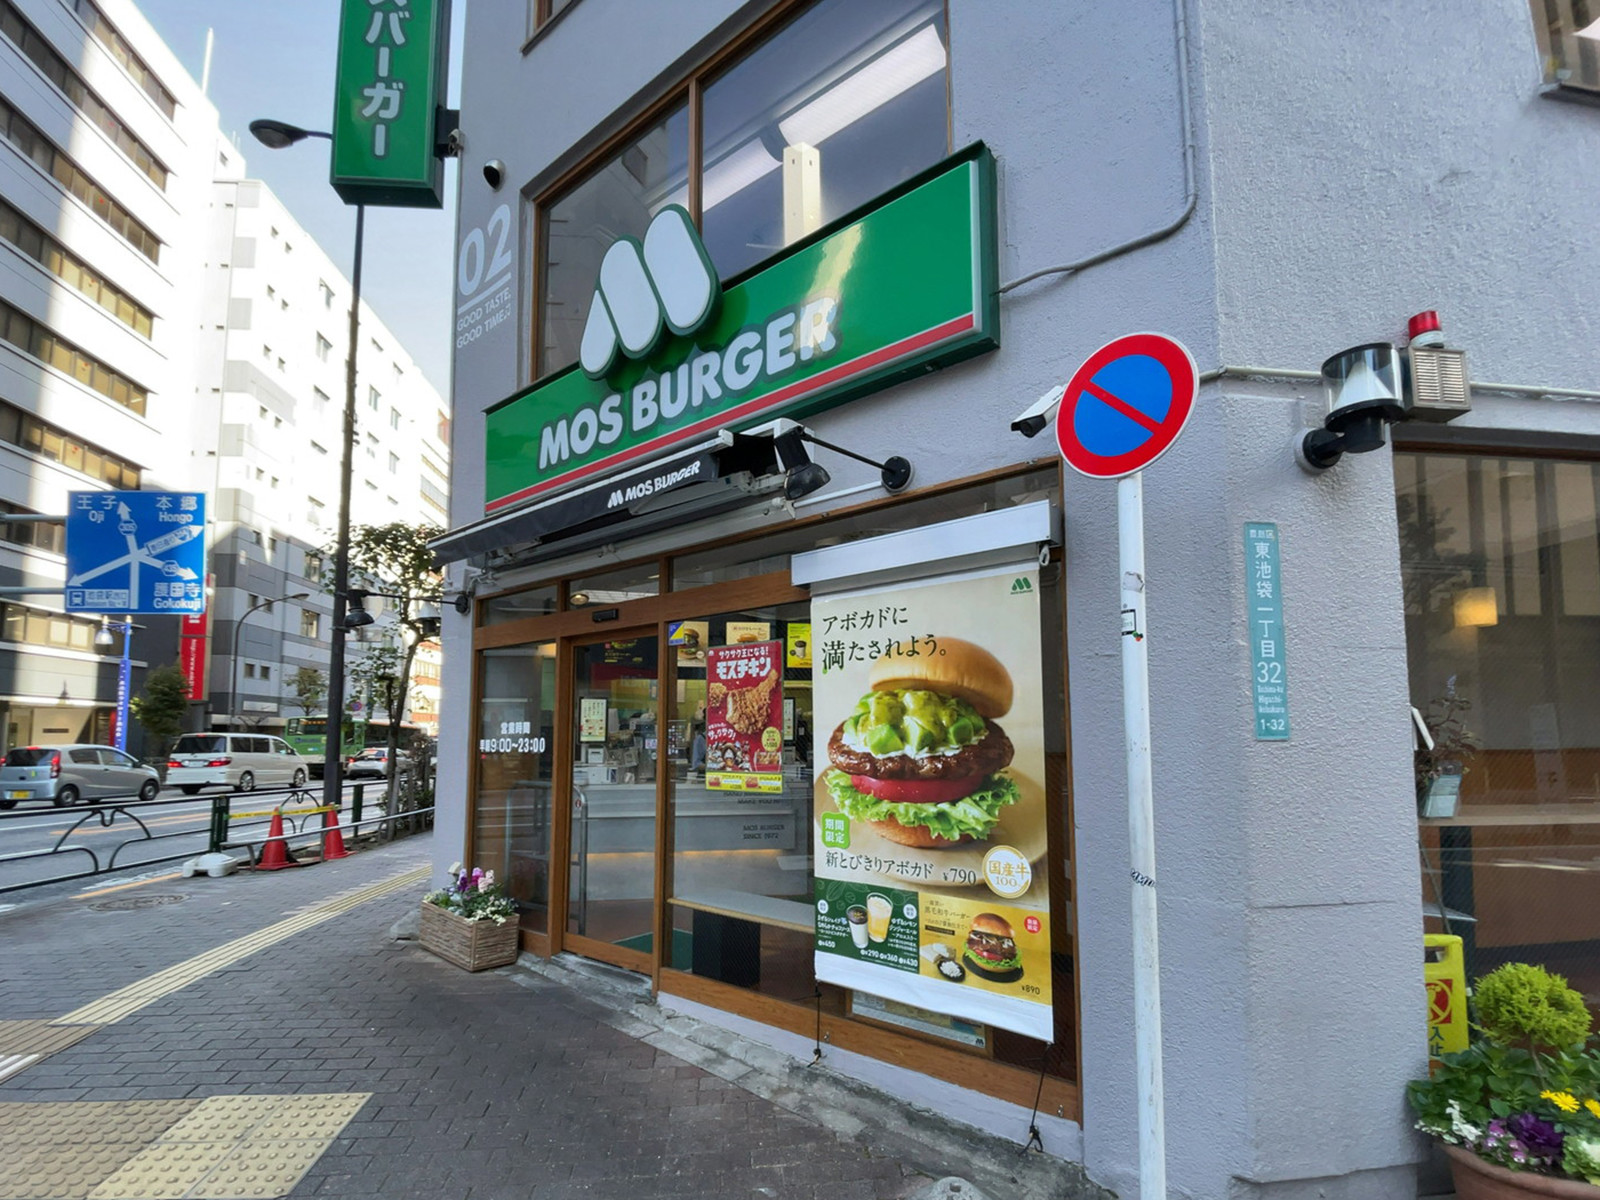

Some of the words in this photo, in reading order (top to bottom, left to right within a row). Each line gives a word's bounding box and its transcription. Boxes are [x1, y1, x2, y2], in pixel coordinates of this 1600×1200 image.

[362, 0, 411, 157] バーガー
[458, 203, 512, 296] 02
[457, 307, 483, 331] GOOD
[456, 325, 482, 348] GOOD
[538, 394, 623, 470] MOS
[632, 297, 837, 432] BURGER
[625, 480, 654, 501] MOS
[654, 460, 701, 491] BURGER
[76, 494, 118, 511] 王子
[155, 495, 198, 511] 本郷
[88, 510, 105, 524] Oji
[158, 511, 194, 524] Hongo
[153, 597, 203, 611] Gokokuji
[1253, 541, 1276, 658] 東池袋一丁目
[821, 606, 909, 636] アボカドに
[821, 634, 949, 672] 満たされよう。
[716, 656, 772, 680] モスチキン
[1256, 661, 1282, 684] 32
[1260, 718, 1286, 731] 1-32
[825, 850, 934, 880] 新とびきりアボカド
[942, 866, 977, 886] ¥790
[988, 860, 1030, 879] 国産牛
[1021, 984, 1041, 995] ¥890
